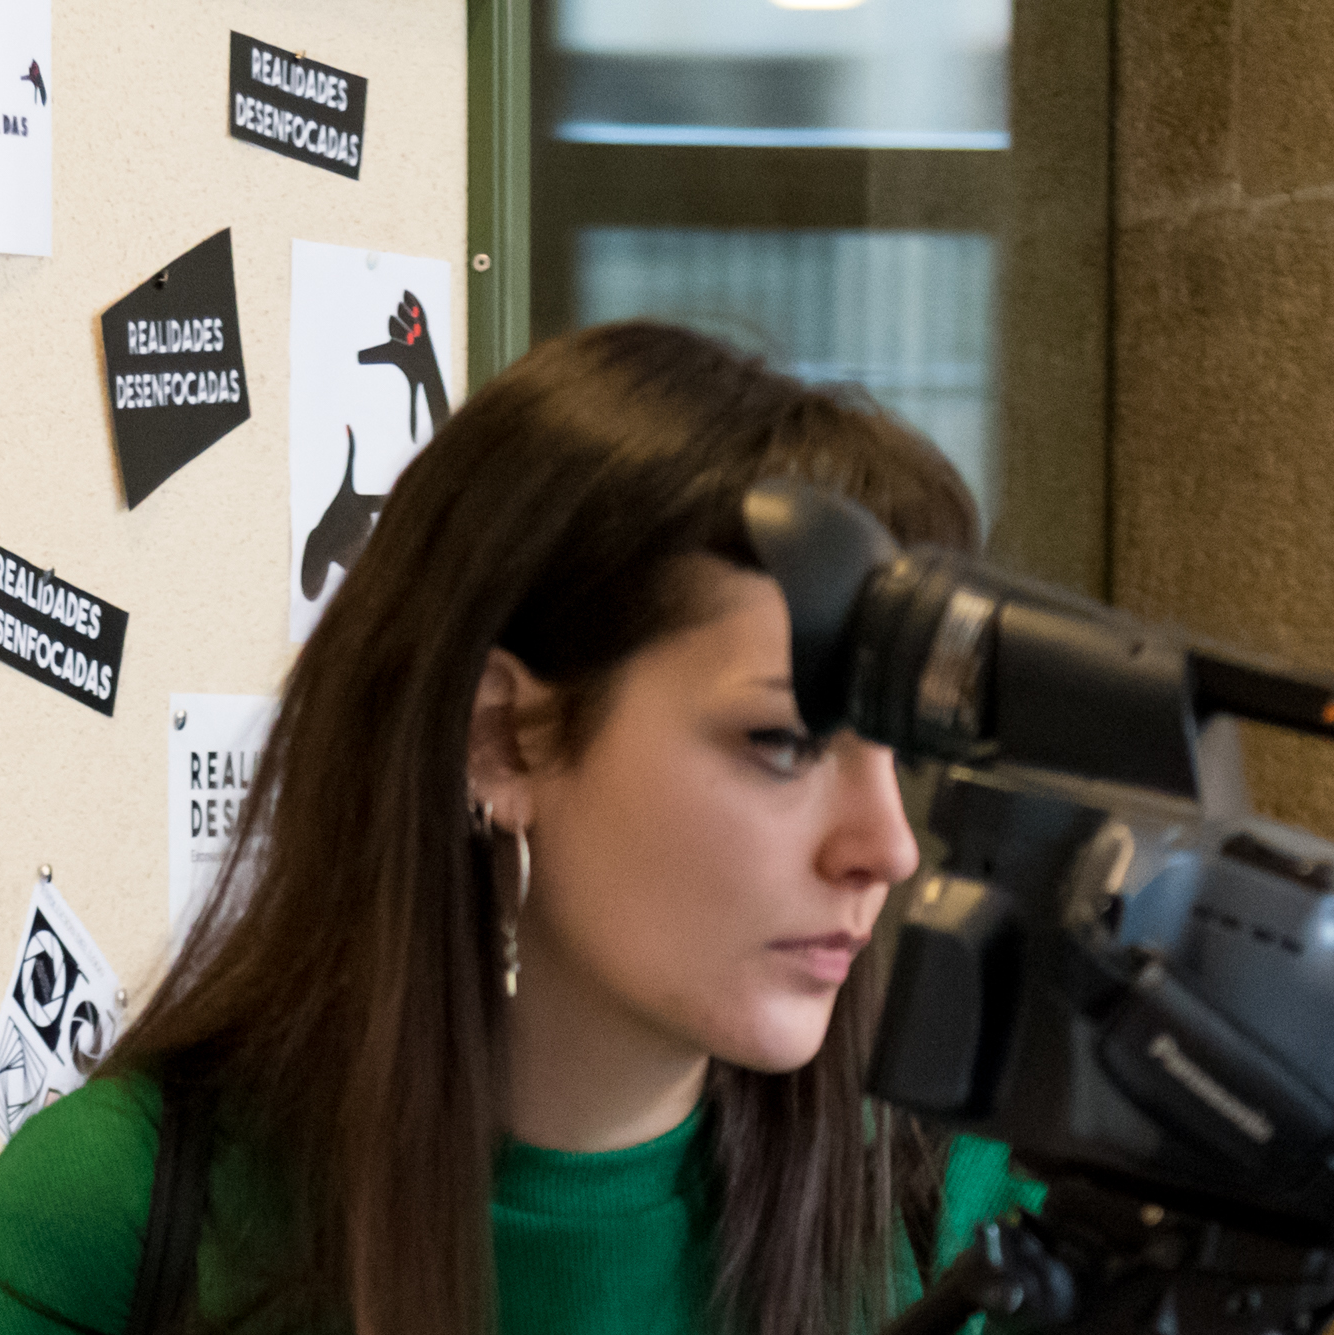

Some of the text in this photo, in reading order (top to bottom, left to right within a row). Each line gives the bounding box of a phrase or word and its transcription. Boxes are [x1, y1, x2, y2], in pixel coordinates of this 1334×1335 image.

[251, 47, 348, 112] REALIDADES
[235, 92, 360, 167] DESENFOCADAS
[128, 317, 224, 354] REALIDADES
[116, 368, 240, 409] DESENFOCADAS
